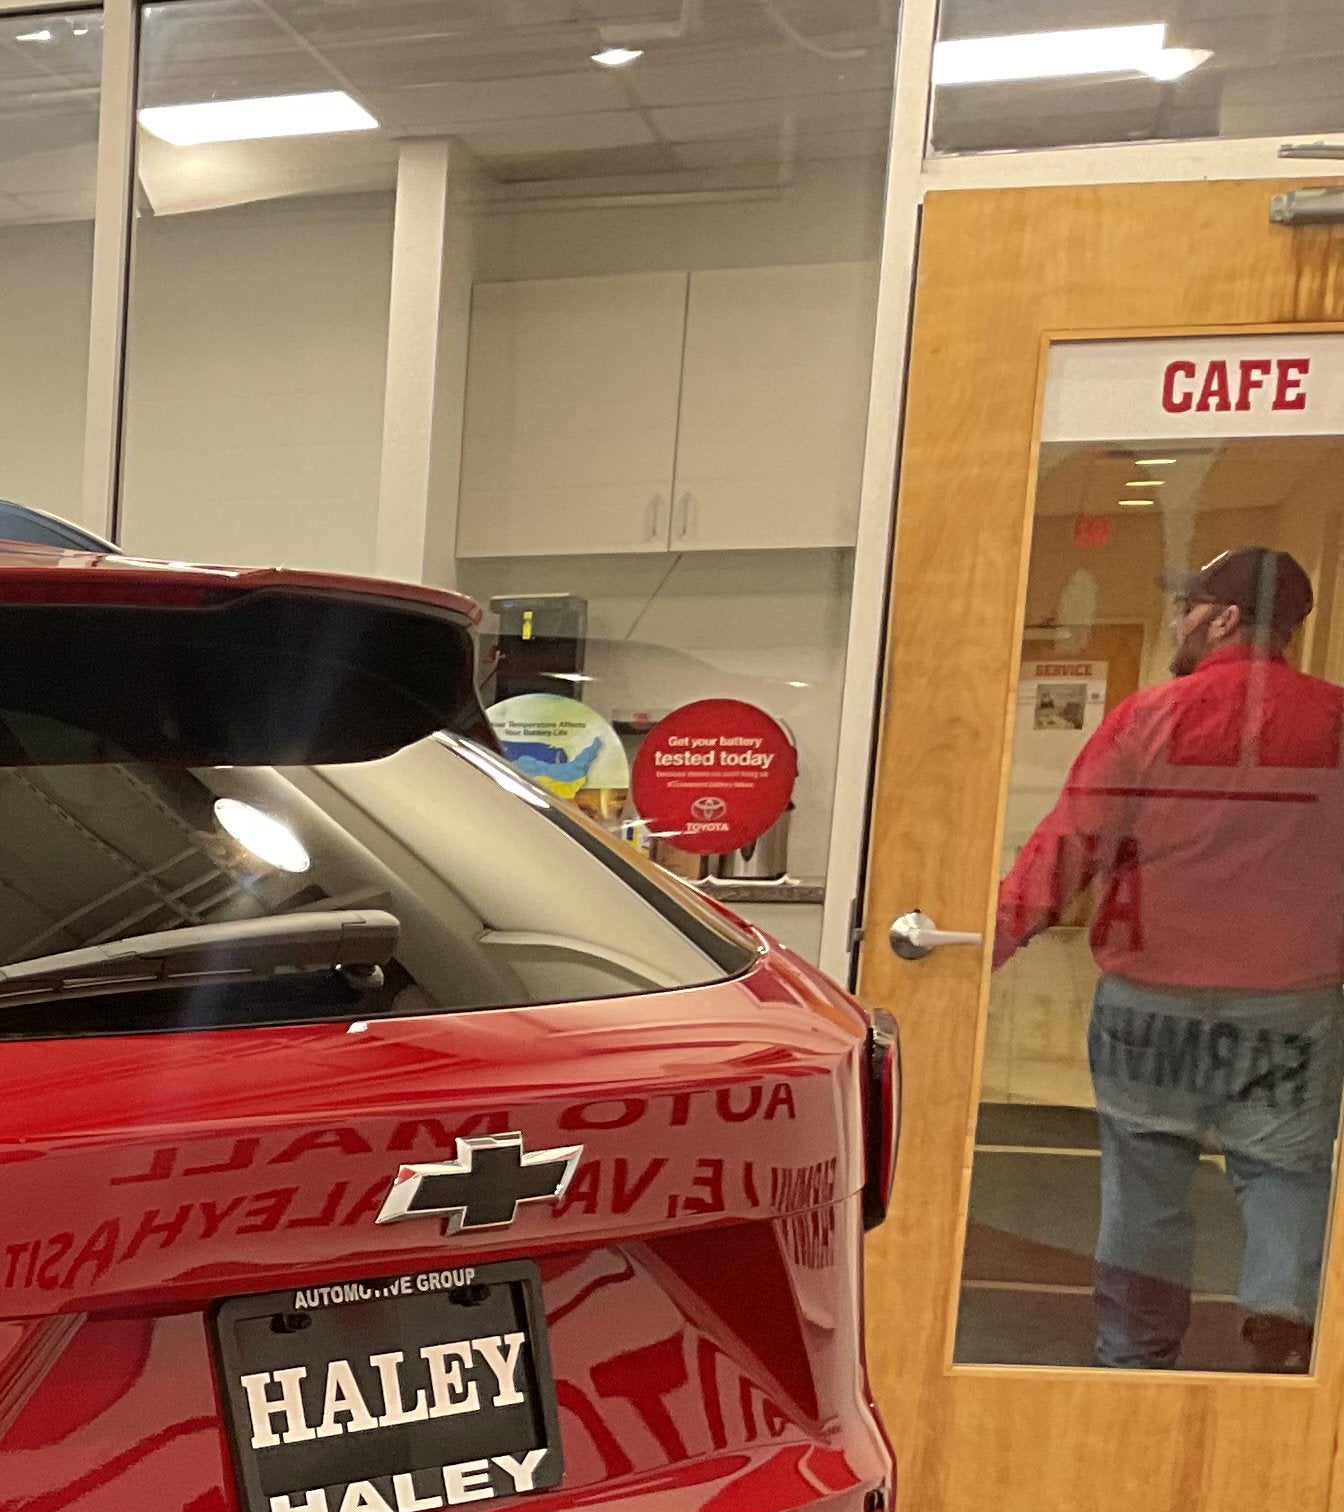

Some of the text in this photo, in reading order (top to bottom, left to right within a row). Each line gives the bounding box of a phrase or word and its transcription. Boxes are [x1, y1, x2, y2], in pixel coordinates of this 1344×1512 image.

[1161, 357, 1311, 415] CAFE
[1034, 663, 1093, 677] SERVICE
[668, 736, 764, 749] Get your battery
[654, 750, 775, 769] tested today
[686, 822, 730, 832] TOYOTA
[416, 1267, 476, 1291] GROUP
[241, 1331, 525, 1450] HALEY
